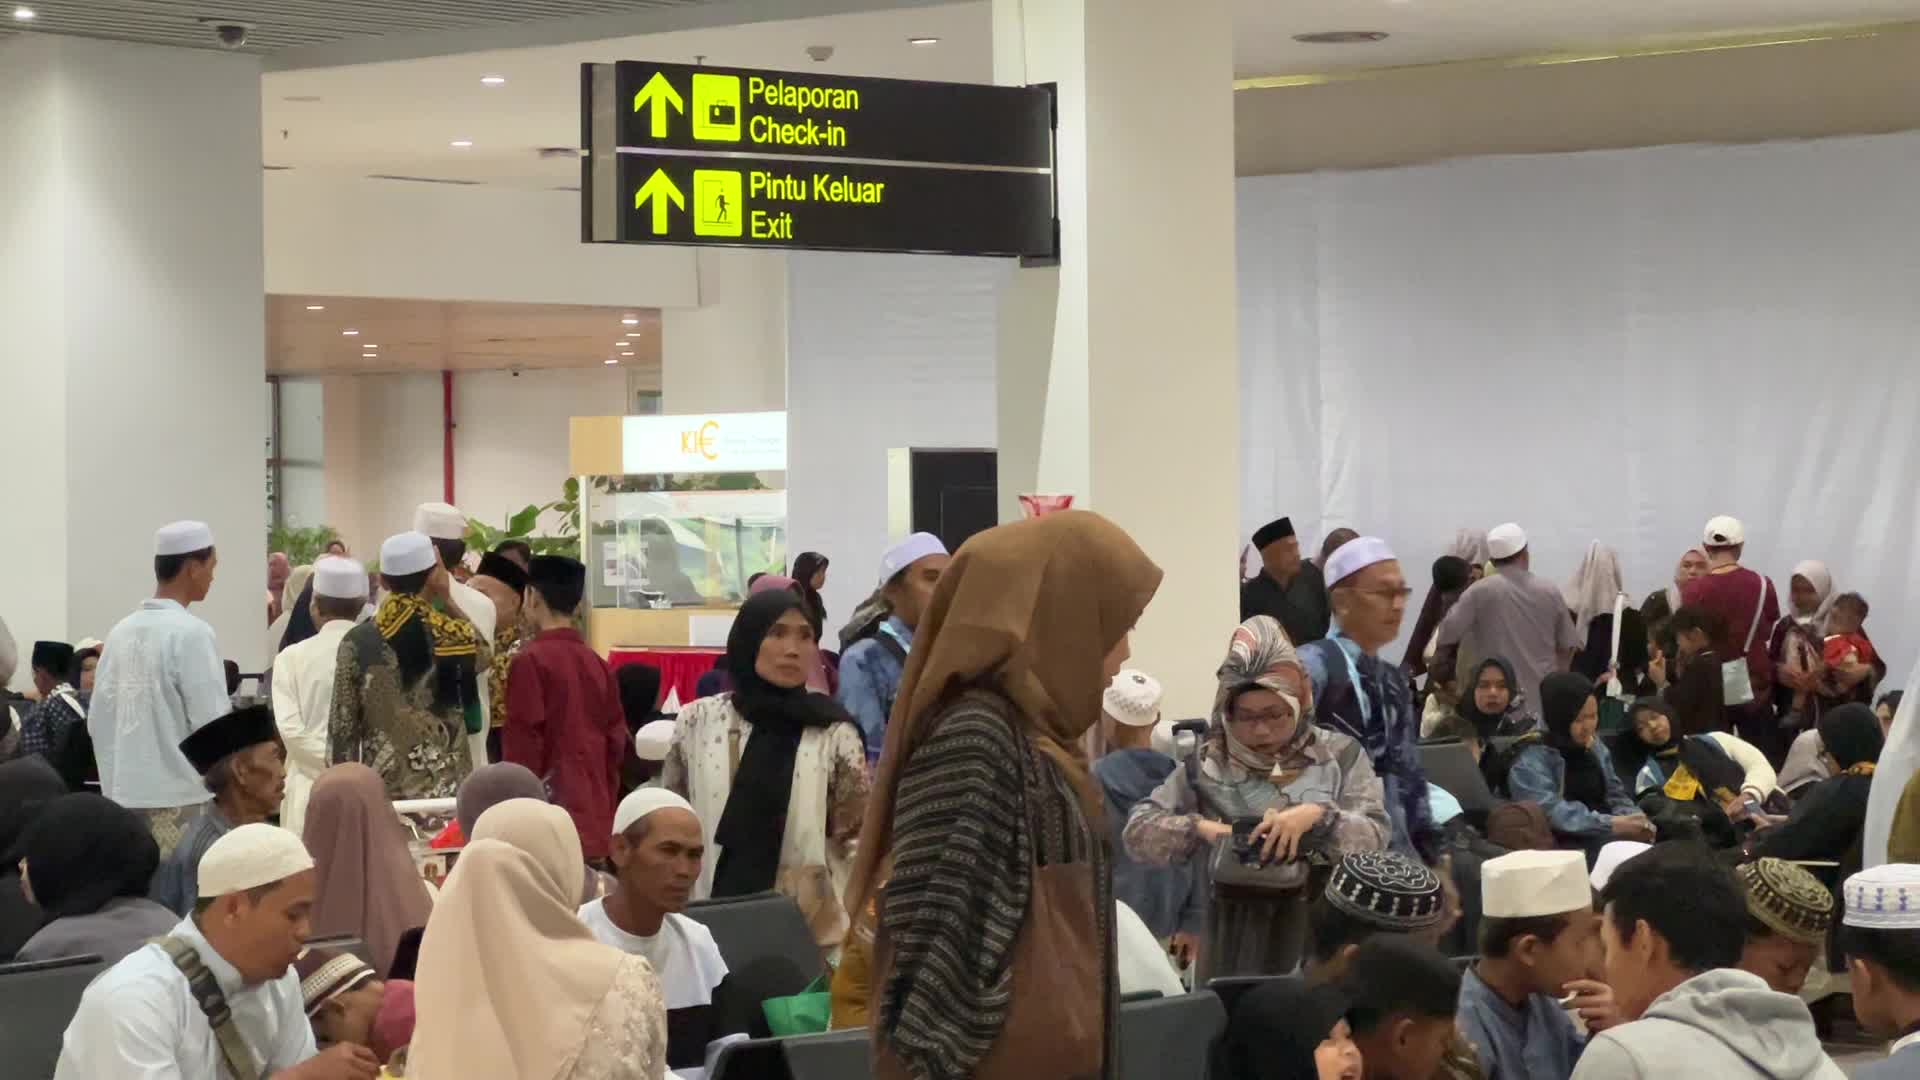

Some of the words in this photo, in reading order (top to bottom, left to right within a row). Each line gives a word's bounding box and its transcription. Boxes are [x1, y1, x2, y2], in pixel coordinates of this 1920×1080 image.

[749, 77, 859, 114] Pelaporan
[749, 115, 846, 146] Check-in
[750, 171, 807, 201] Pintu
[813, 173, 885, 204] Keluar
[750, 210, 793, 240] Exit
